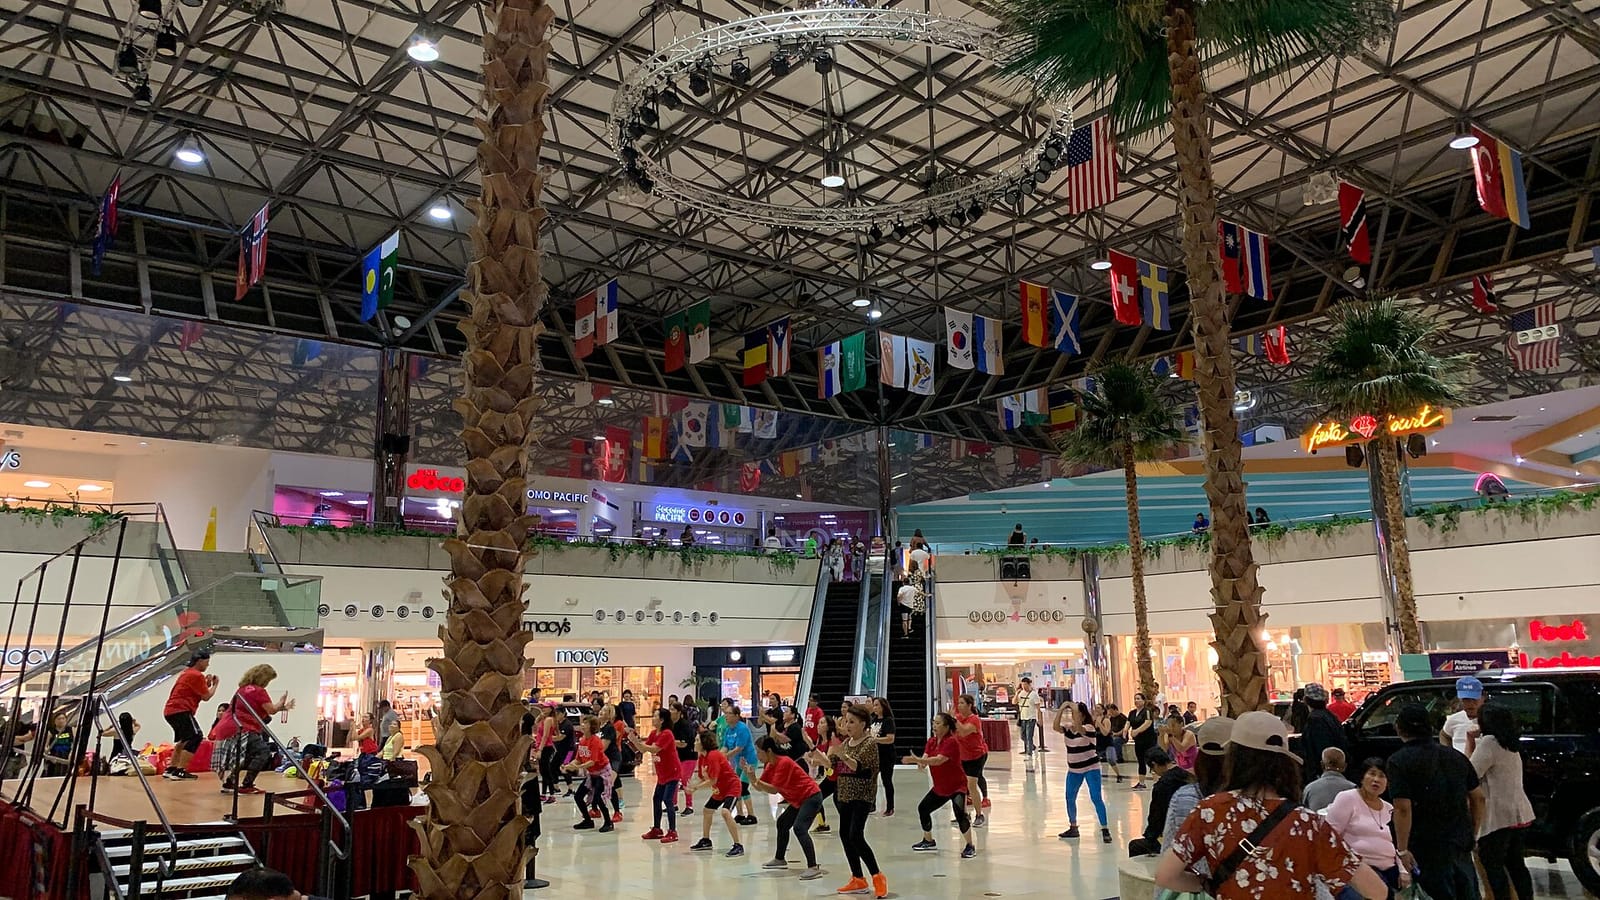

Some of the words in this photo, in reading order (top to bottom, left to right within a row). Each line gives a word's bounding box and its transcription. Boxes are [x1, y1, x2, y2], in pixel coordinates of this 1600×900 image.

[1388, 405, 1444, 432] ourt
[553, 492, 589, 503] PACIFIC
[655, 512, 686, 523] PACIFIC
[556, 647, 609, 665] macy's
